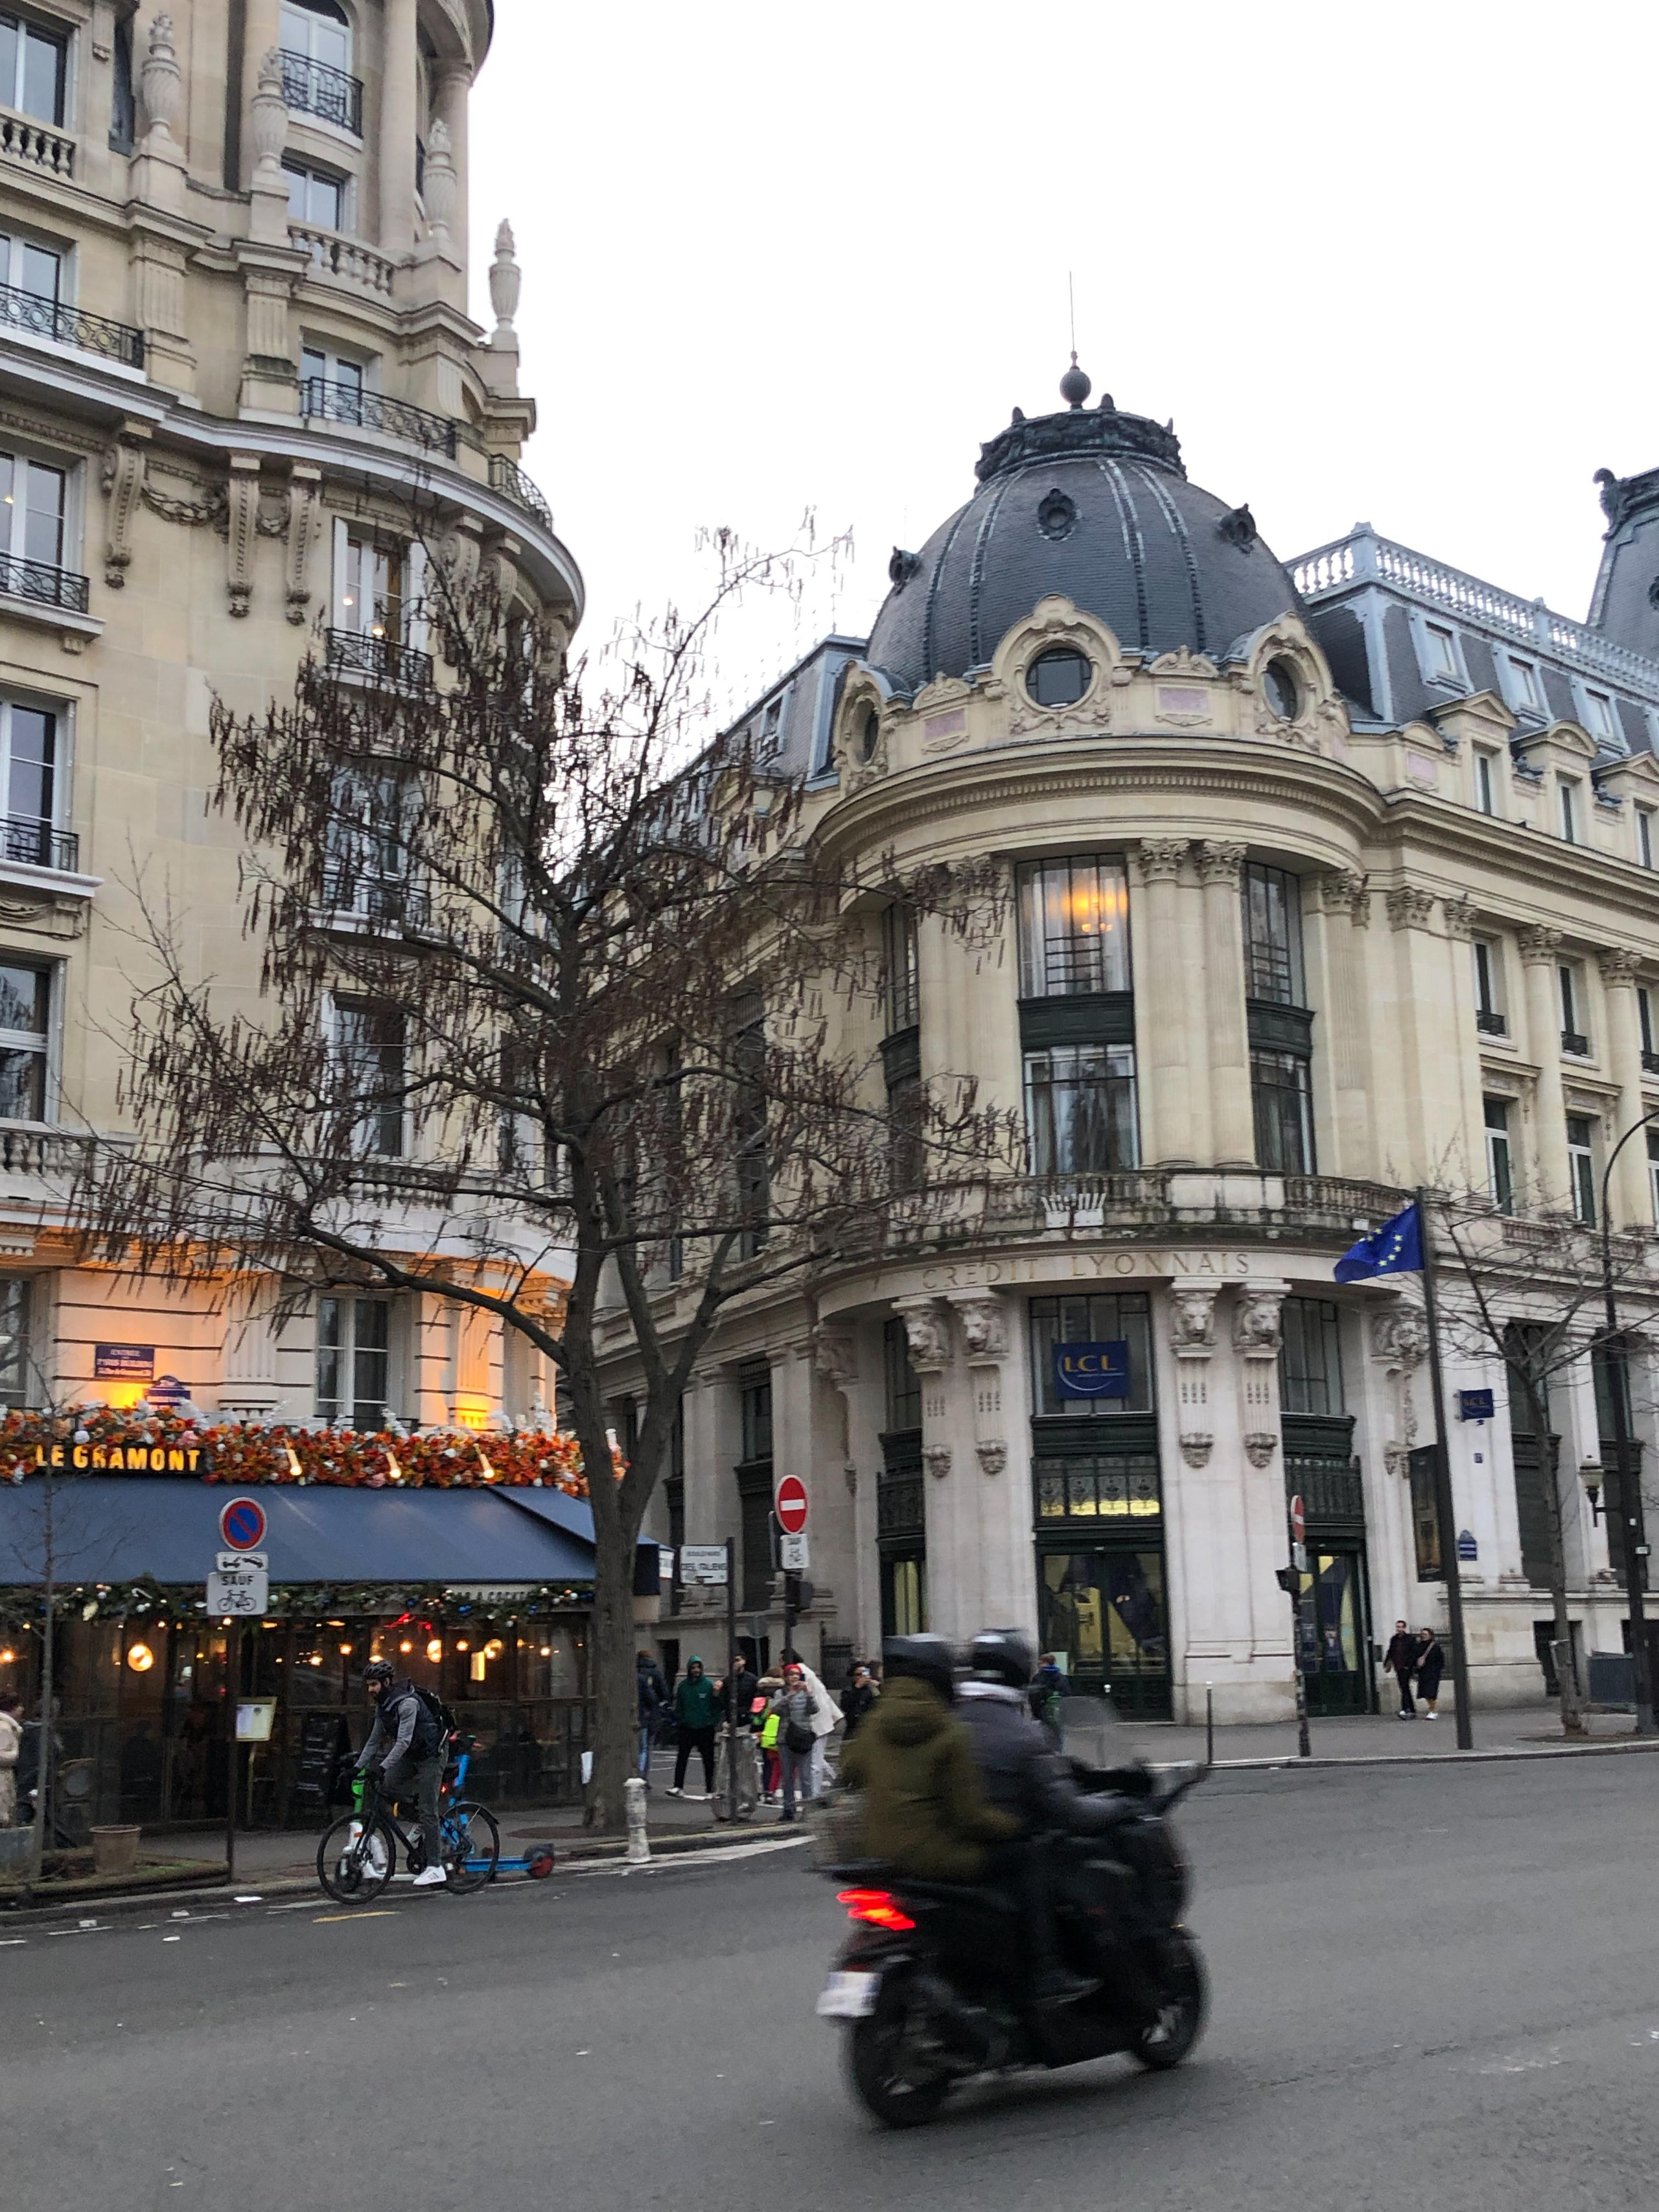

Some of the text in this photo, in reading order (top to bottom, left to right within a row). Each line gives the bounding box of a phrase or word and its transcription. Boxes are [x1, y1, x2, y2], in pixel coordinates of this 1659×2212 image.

[922, 1253, 1249, 1289] CREDIT LYONNAIS
[1064, 1355, 1119, 1372] LCL
[35, 1444, 200, 1471] LE GRAMONT
[221, 1575, 254, 1586] SAUF
